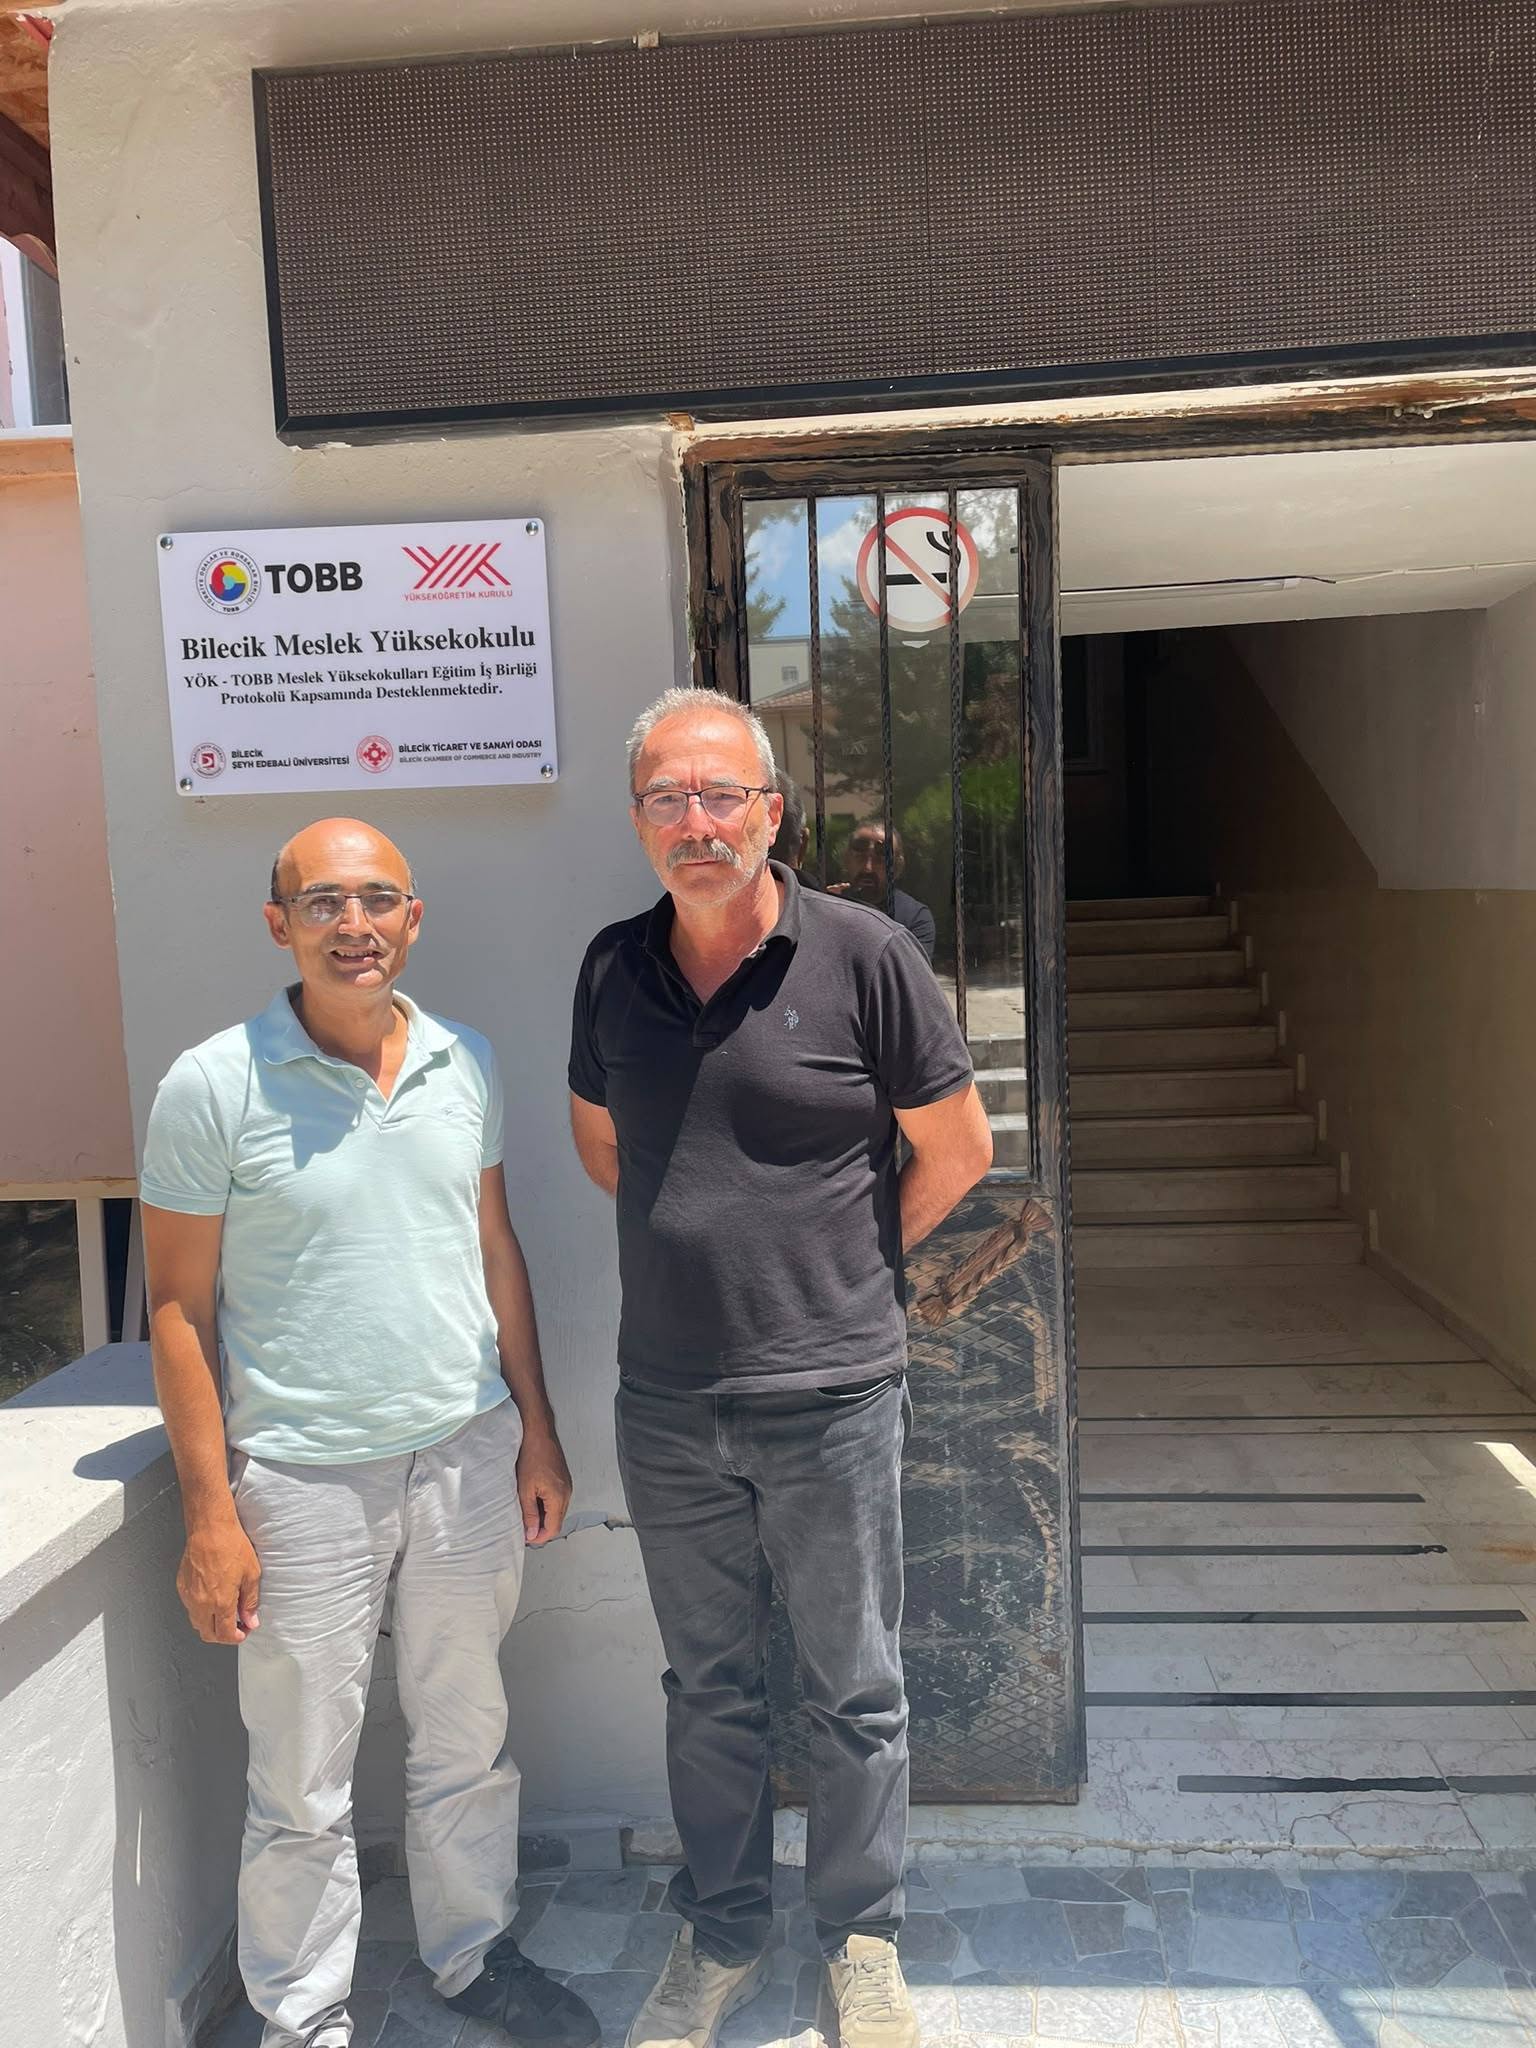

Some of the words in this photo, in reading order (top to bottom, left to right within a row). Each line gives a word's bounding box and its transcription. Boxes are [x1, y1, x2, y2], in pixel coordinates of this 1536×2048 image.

[265, 561, 363, 594] TOBB
[478, 589, 513, 599] KURULU
[181, 636, 267, 660] Bilecik
[274, 632, 363, 656] Meslek
[370, 625, 535, 653] Yüksekokulu
[184, 673, 219, 688] YÖK
[231, 673, 273, 687] TOBB
[277, 671, 324, 685] Meslek
[327, 666, 428, 683] Yüksekokulları
[432, 665, 476, 681] Eğitim
[480, 661, 492, 679] İş
[496, 661, 537, 677] Birliği
[221, 691, 286, 704] Protokolü
[290, 687, 372, 704] Kapsamında
[376, 683, 503, 699] Desteklenmektedir.
[399, 742, 431, 752] BİLECİK
[433, 741, 468, 751] TİCARET
[469, 742, 481, 750] VE
[483, 739, 514, 749] SANAYİ
[516, 739, 542, 748] ODASI
[231, 749, 263, 758] BİLECİK
[463, 753, 497, 761] COMMERCE
[232, 761, 254, 769] ŞEYH
[256, 758, 291, 768] EDEBALİ
[293, 755, 350, 767] ÜNİVERSİTESİ
